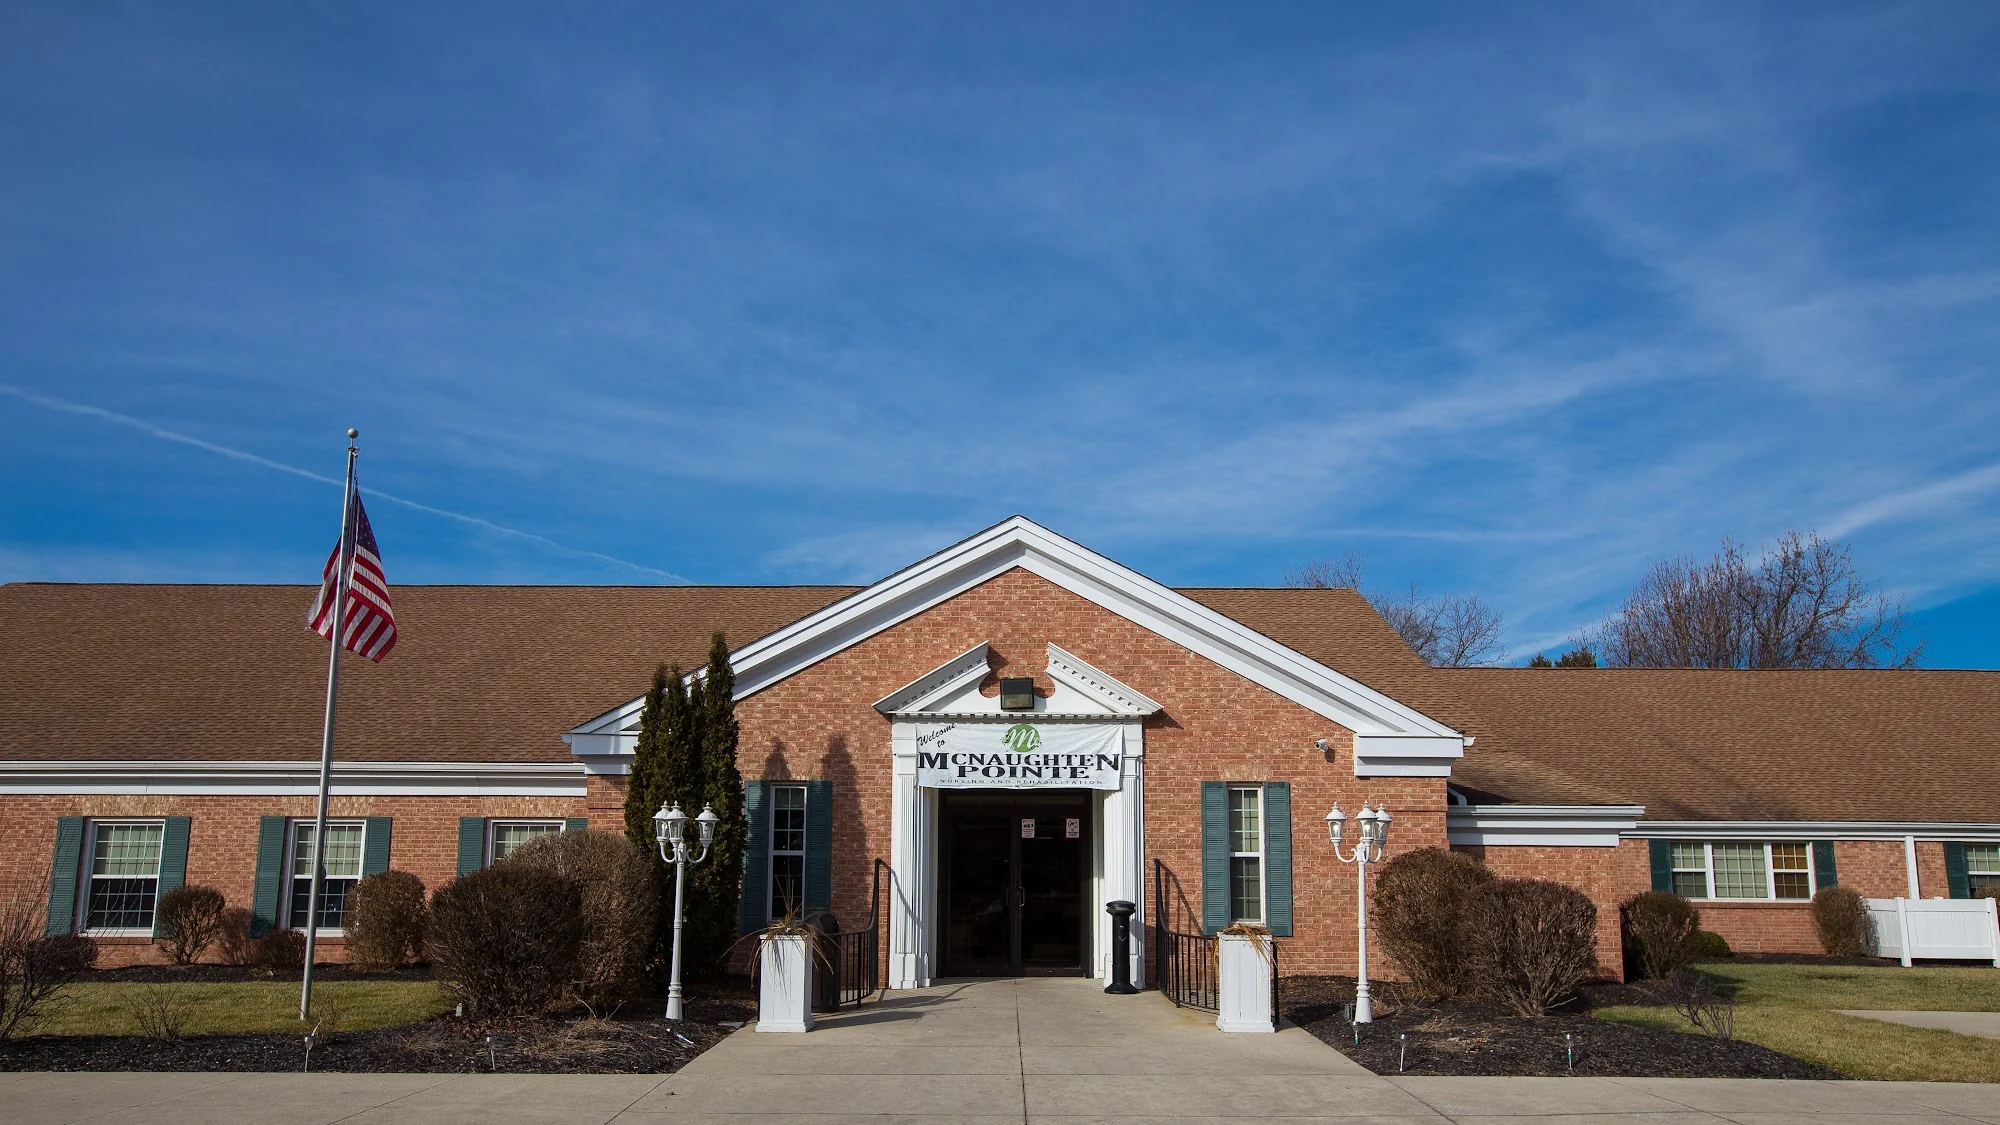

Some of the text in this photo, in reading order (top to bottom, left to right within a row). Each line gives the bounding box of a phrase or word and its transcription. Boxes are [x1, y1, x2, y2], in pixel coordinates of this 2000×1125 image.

[917, 723, 956, 746] Welcome
[936, 739, 946, 748] to
[917, 752, 1120, 771] MCNAUGHTEN
[957, 766, 1090, 779] POINTE
